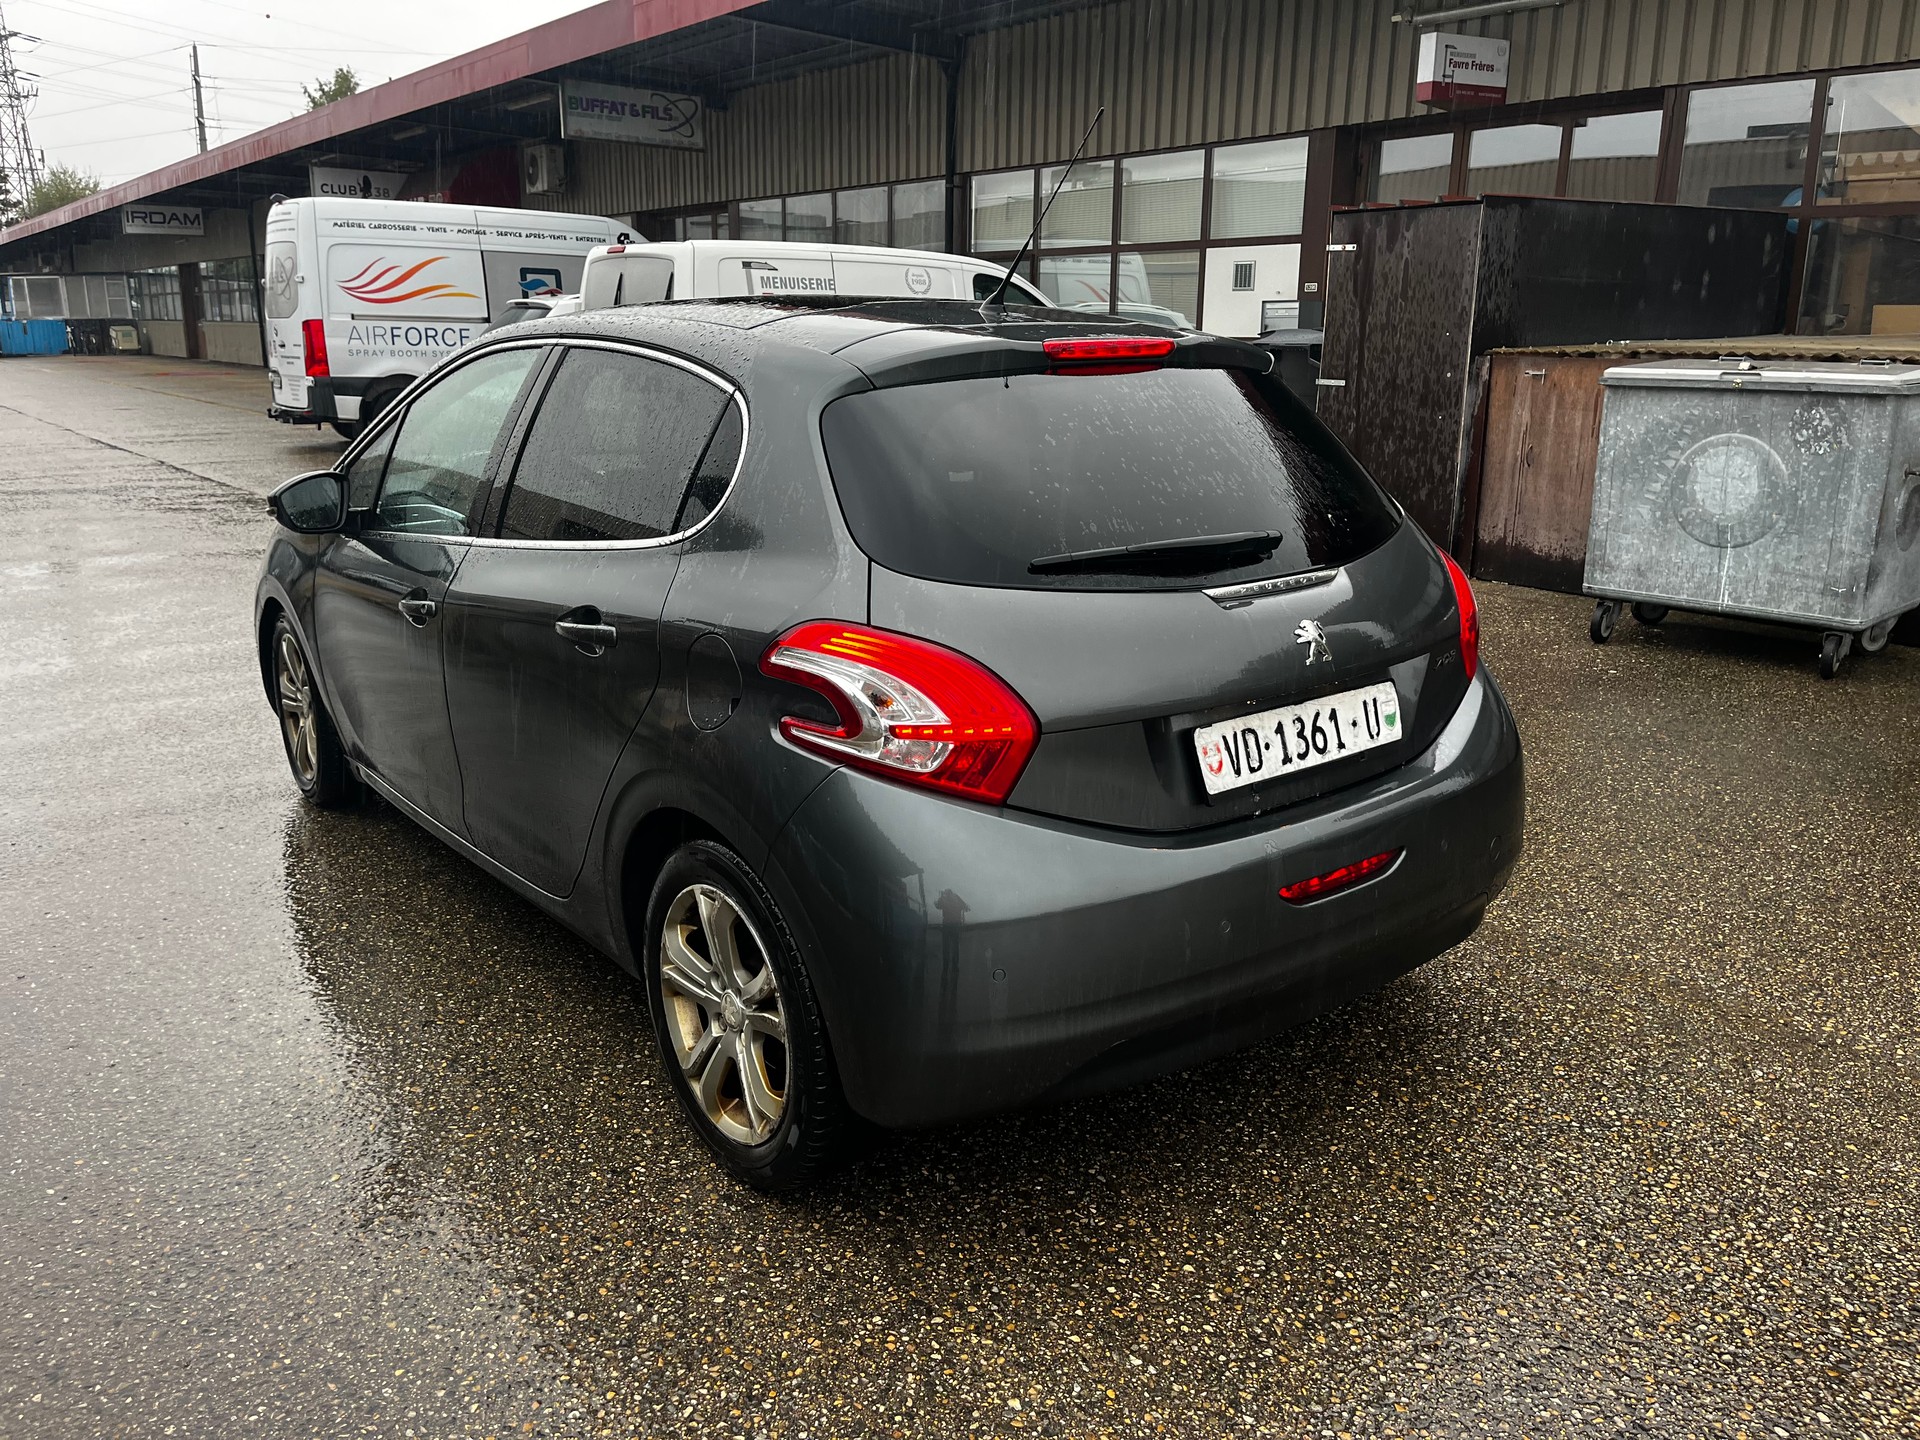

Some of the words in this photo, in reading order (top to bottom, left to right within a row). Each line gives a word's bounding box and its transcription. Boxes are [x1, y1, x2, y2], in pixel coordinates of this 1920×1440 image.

[1448, 58, 1469, 70] Favre
[1471, 60, 1495, 72] Frères
[567, 95, 627, 116] BUFFAT
[641, 104, 673, 122] FILS
[320, 182, 358, 196] CLUB
[374, 186, 391, 198] 38
[125, 210, 201, 226] IRDAM
[368, 222, 417, 232] CARROSSERIE
[456, 228, 487, 236] MONTAGE
[496, 230, 523, 238] SERVICE
[525, 232, 568, 241] APRÈS-VENTE
[760, 275, 835, 291] MENUISERIE
[911, 278, 927, 286] 1988
[347, 325, 471, 347] AIRFORCE
[348, 348, 385, 357] SPRAY
[390, 349, 428, 358] BOOTH
